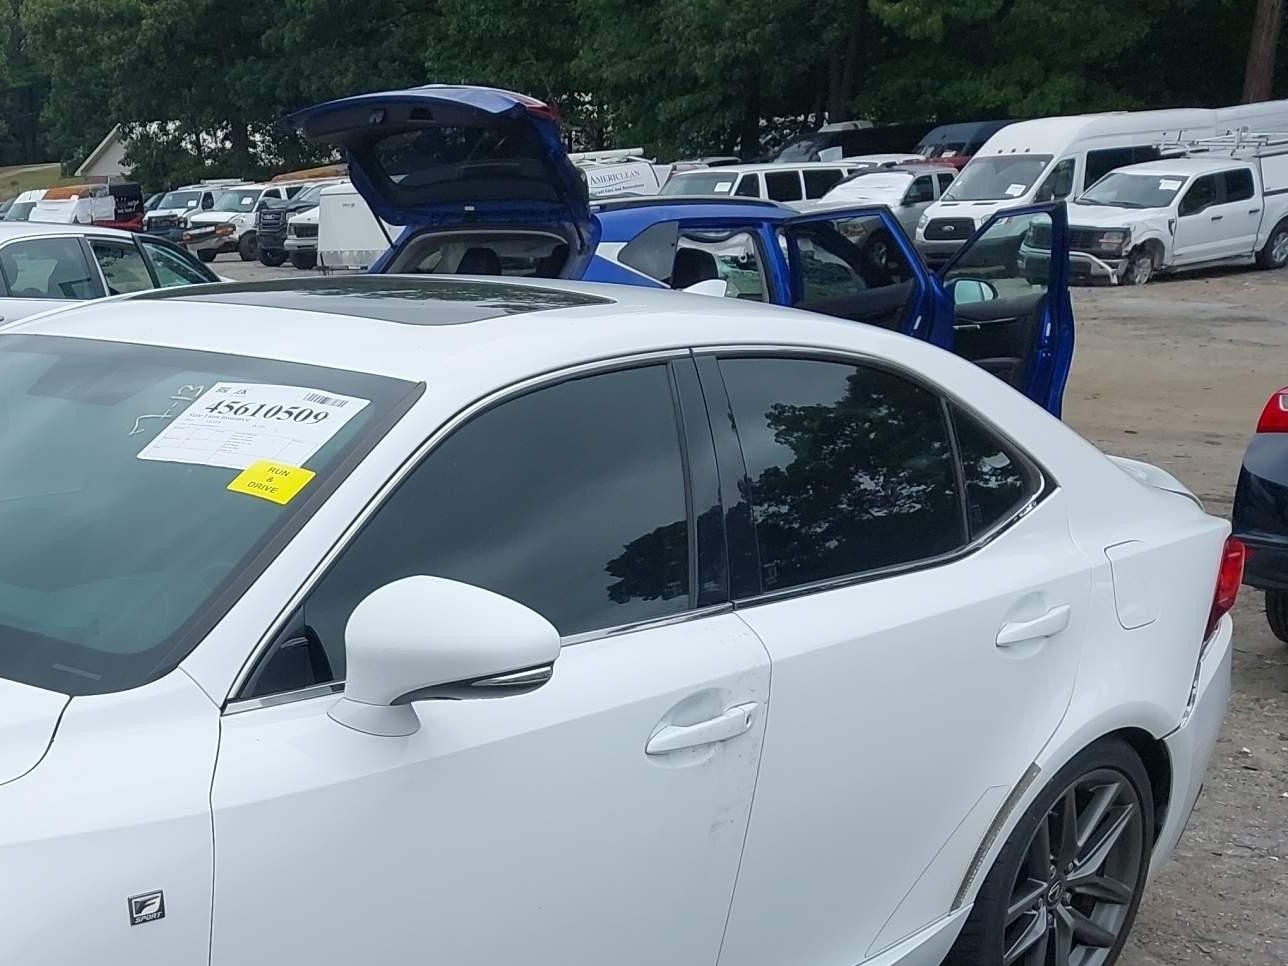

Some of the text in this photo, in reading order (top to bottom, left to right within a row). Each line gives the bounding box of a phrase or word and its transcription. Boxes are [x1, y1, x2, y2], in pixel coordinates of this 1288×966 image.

[205, 400, 329, 424] 45610509
[267, 467, 290, 477] RUN
[247, 481, 279, 494] DRIVE
